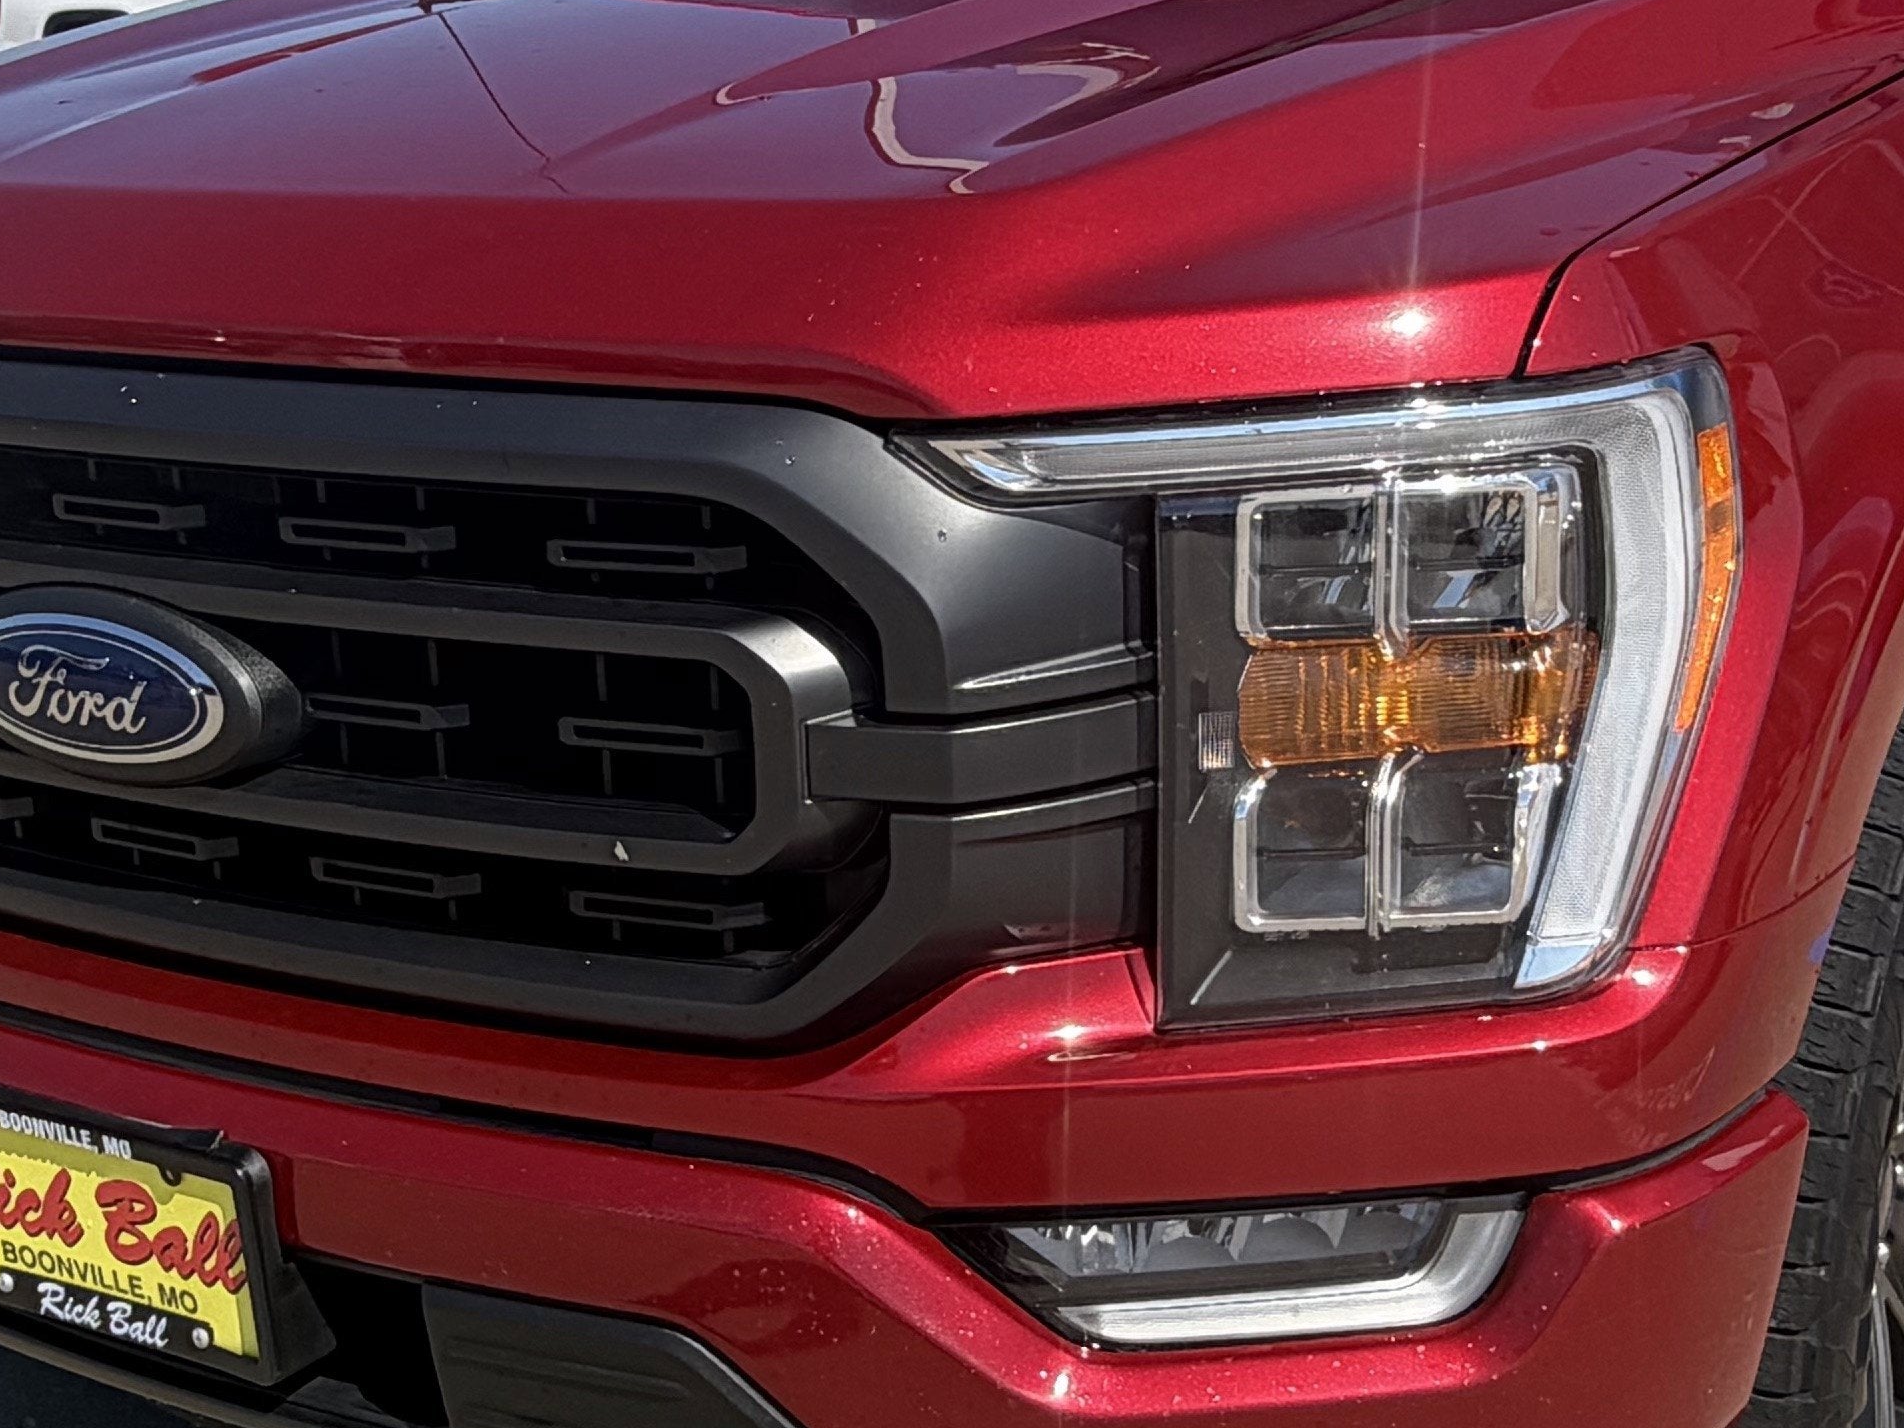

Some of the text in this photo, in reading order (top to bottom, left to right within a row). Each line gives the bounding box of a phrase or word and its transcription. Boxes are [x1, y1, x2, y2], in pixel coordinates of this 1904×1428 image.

[8, 643, 147, 734] Ford
[101, 1134, 132, 1160] MO
[94, 1178, 247, 1295] Ball
[1, 1238, 198, 1315] BOONVILLE, MO
[37, 1281, 170, 1349] Rick Ball
